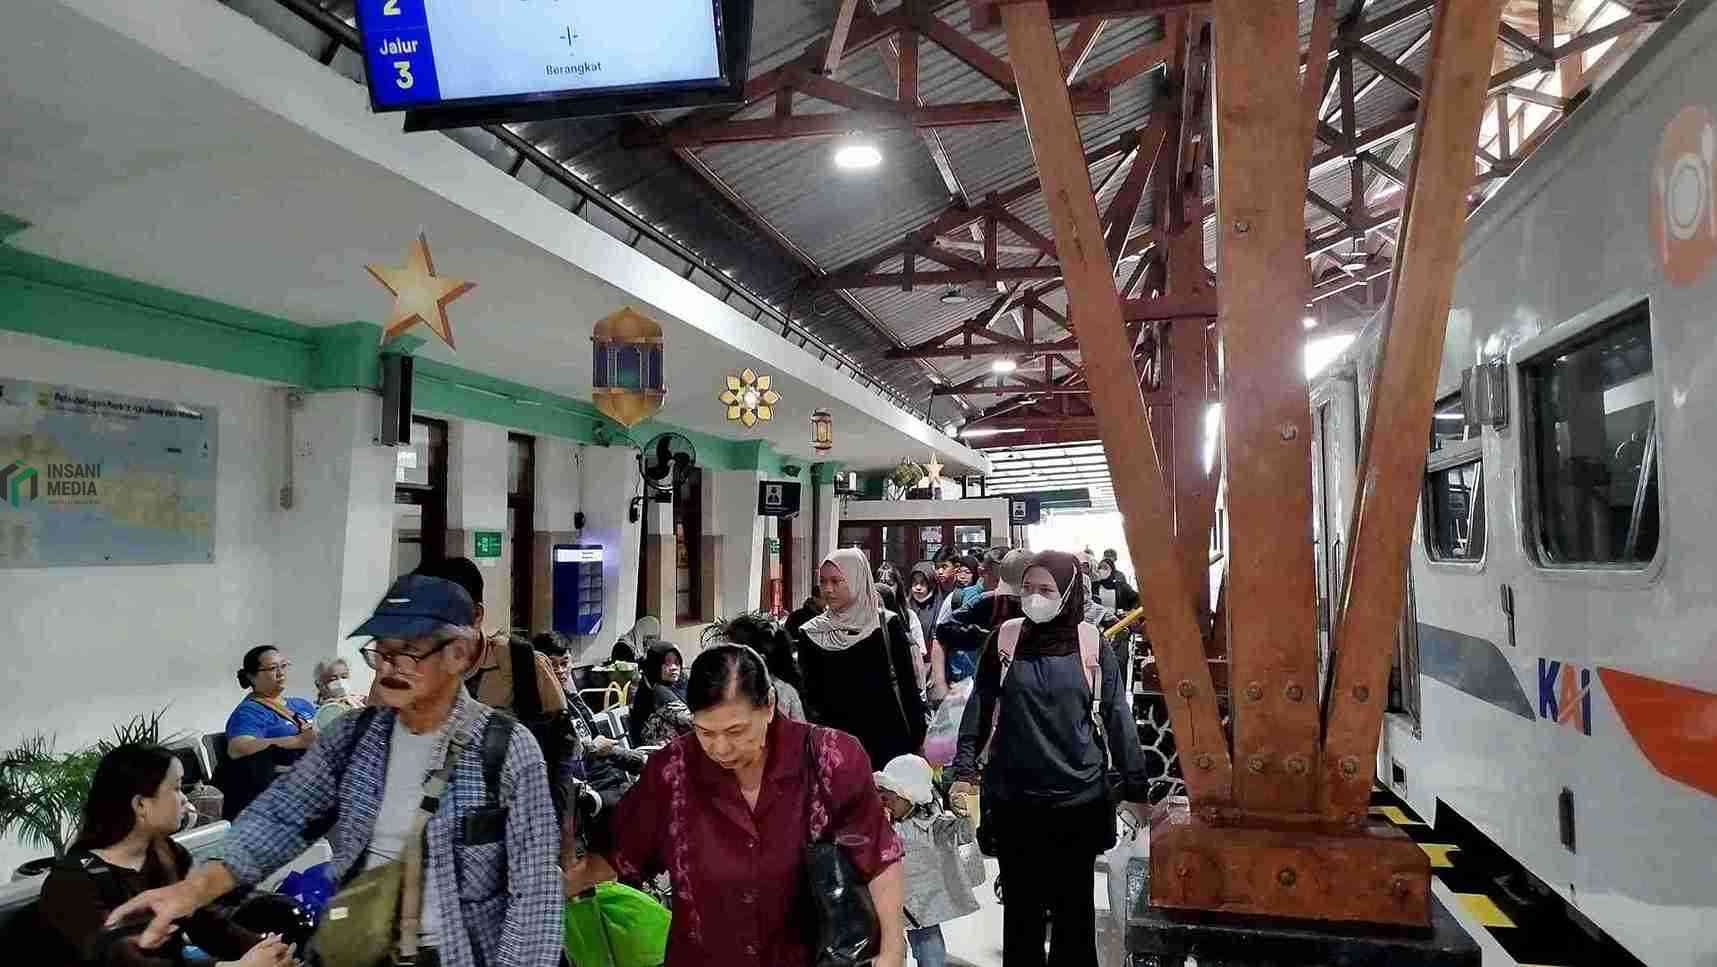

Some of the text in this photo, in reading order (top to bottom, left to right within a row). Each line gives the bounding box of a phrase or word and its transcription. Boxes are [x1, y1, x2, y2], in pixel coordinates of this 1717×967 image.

[383, 0, 401, 16] 2
[380, 36, 418, 55] Jalur
[393, 61, 414, 89] 3
[546, 61, 601, 76] Berangkat
[1538, 657, 1592, 737] KAI
